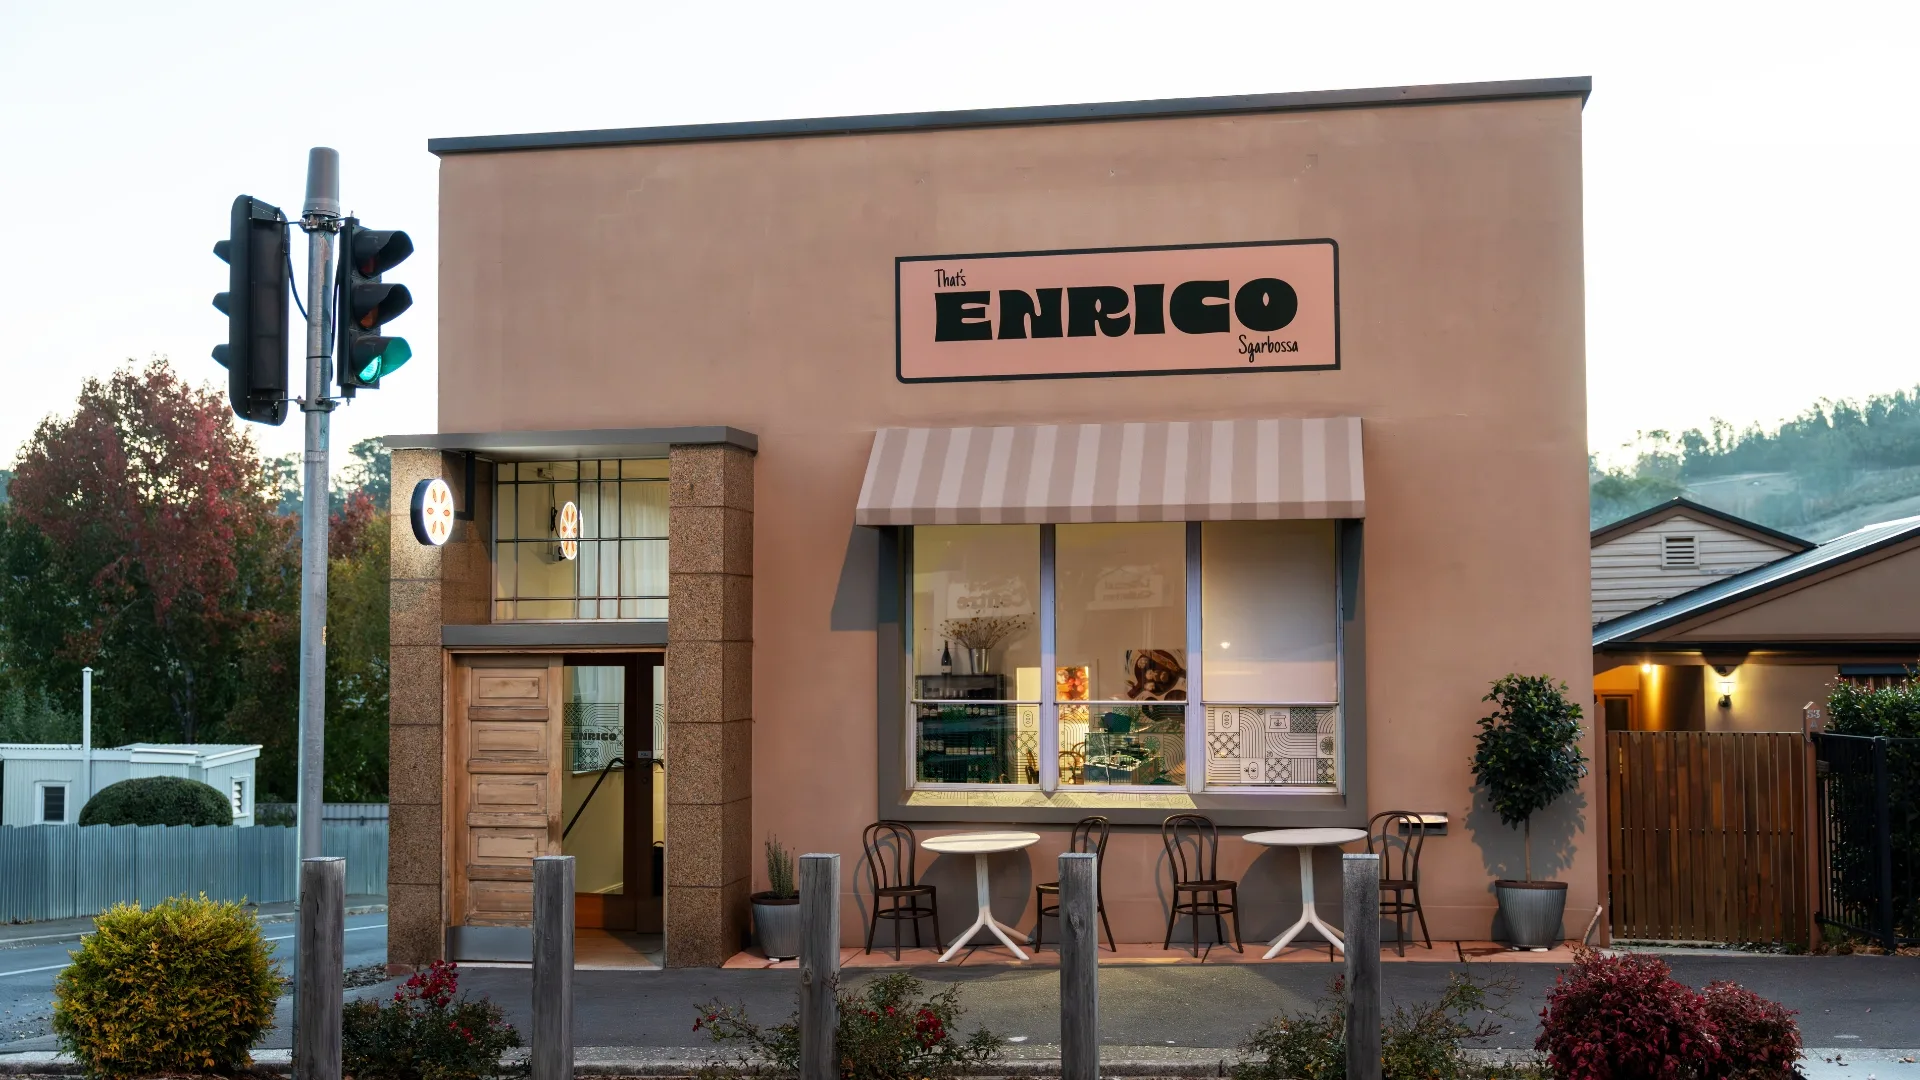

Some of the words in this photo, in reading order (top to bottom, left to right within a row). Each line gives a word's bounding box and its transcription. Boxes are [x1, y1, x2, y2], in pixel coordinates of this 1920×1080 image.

[934, 268, 966, 288] That's
[934, 277, 1298, 342] ENRICO
[1238, 334, 1298, 363] Sgarbossa
[1807, 709, 1821, 719] 53
[571, 732, 617, 741] ENRICO
